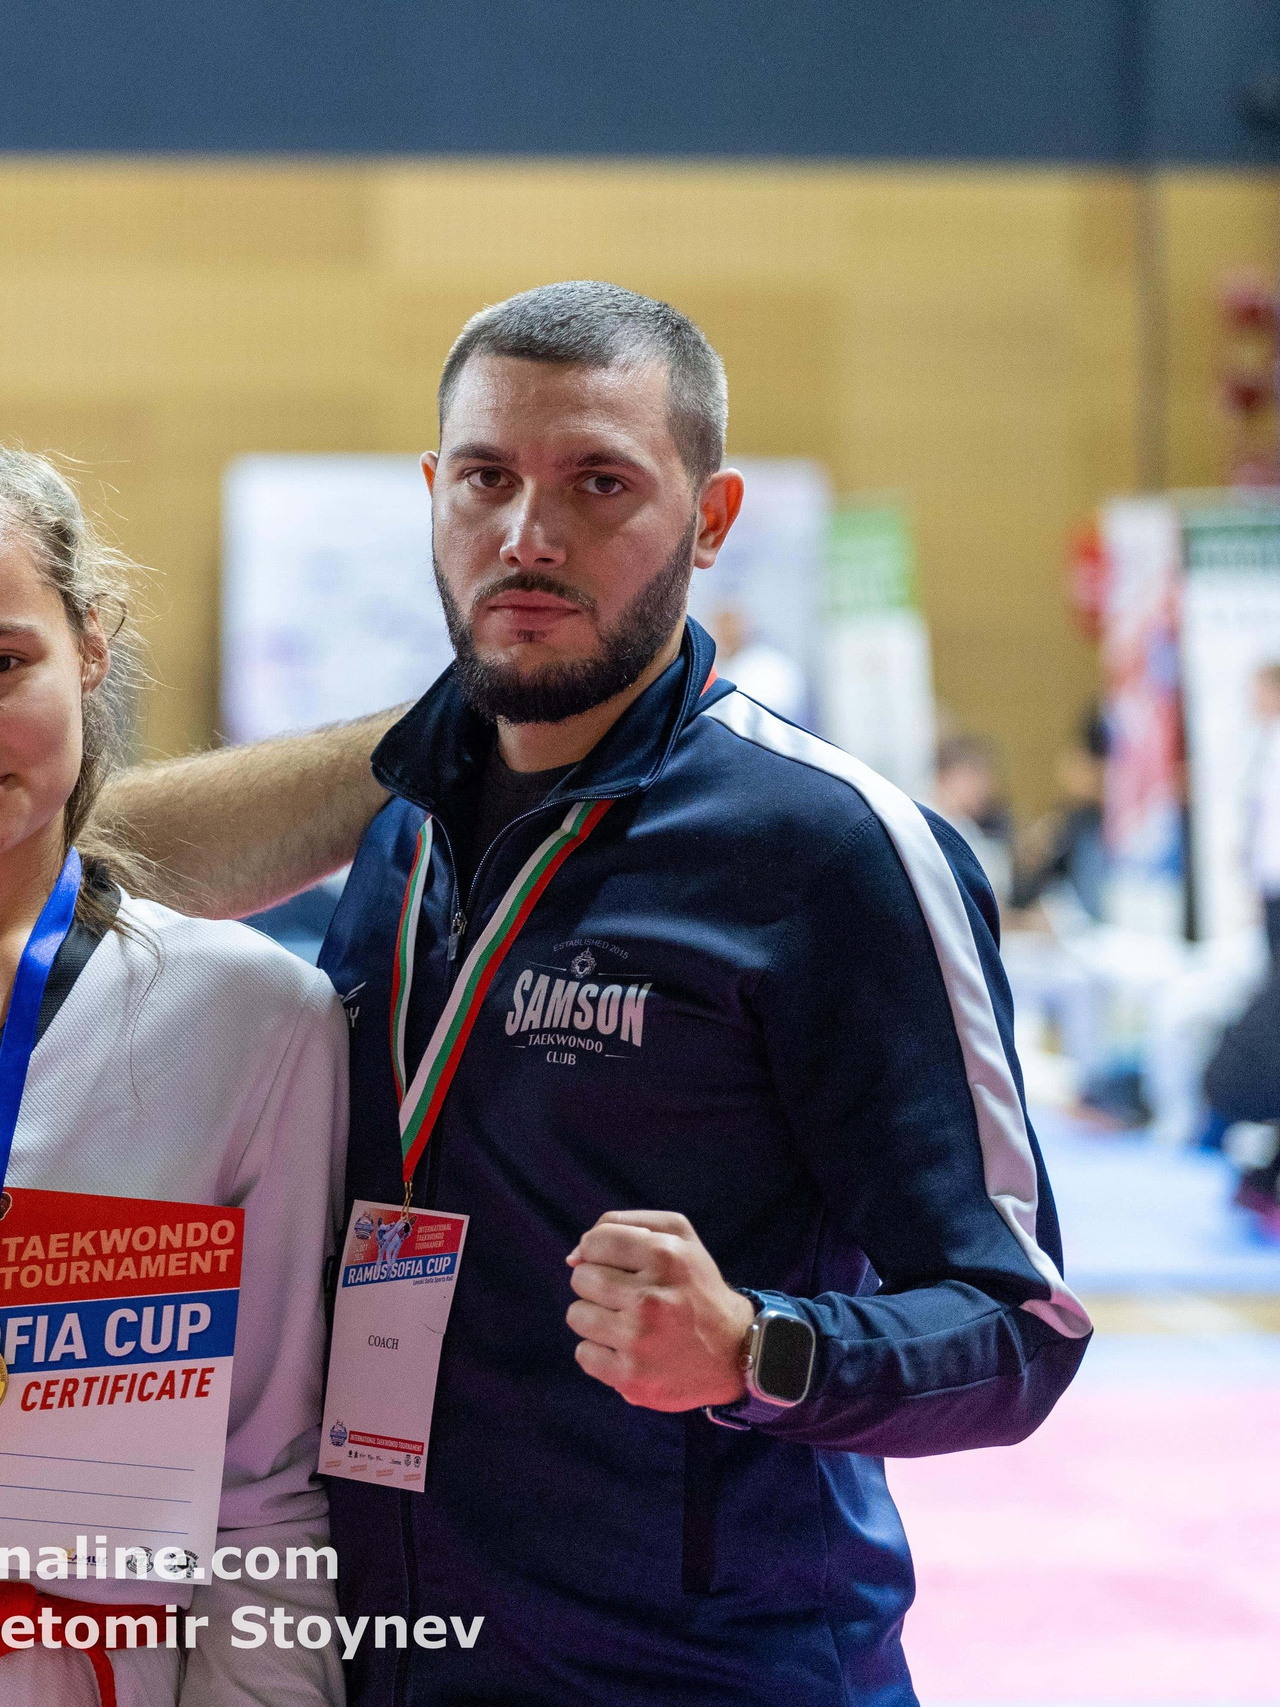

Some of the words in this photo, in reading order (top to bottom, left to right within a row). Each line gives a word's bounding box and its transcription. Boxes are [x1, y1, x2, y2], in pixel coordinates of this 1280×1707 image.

[553, 938, 609, 951] ESTABLISHED
[609, 945, 629, 960] 2015
[505, 969, 653, 1048] SAMSON
[528, 1034, 603, 1053] TAEKWONDO
[546, 1051, 577, 1065] CLUB
[1, 1219, 236, 1262] TAEKWONDO
[0, 1249, 234, 1290] TOURNAMENT
[347, 1264, 388, 1284] RAMUS
[390, 1259, 423, 1279] SOFIA
[426, 1256, 451, 1275] CUP
[104, 1302, 212, 1357] CUP
[368, 1334, 399, 1350] COACH
[21, 1366, 216, 1412] CERTIFICATE
